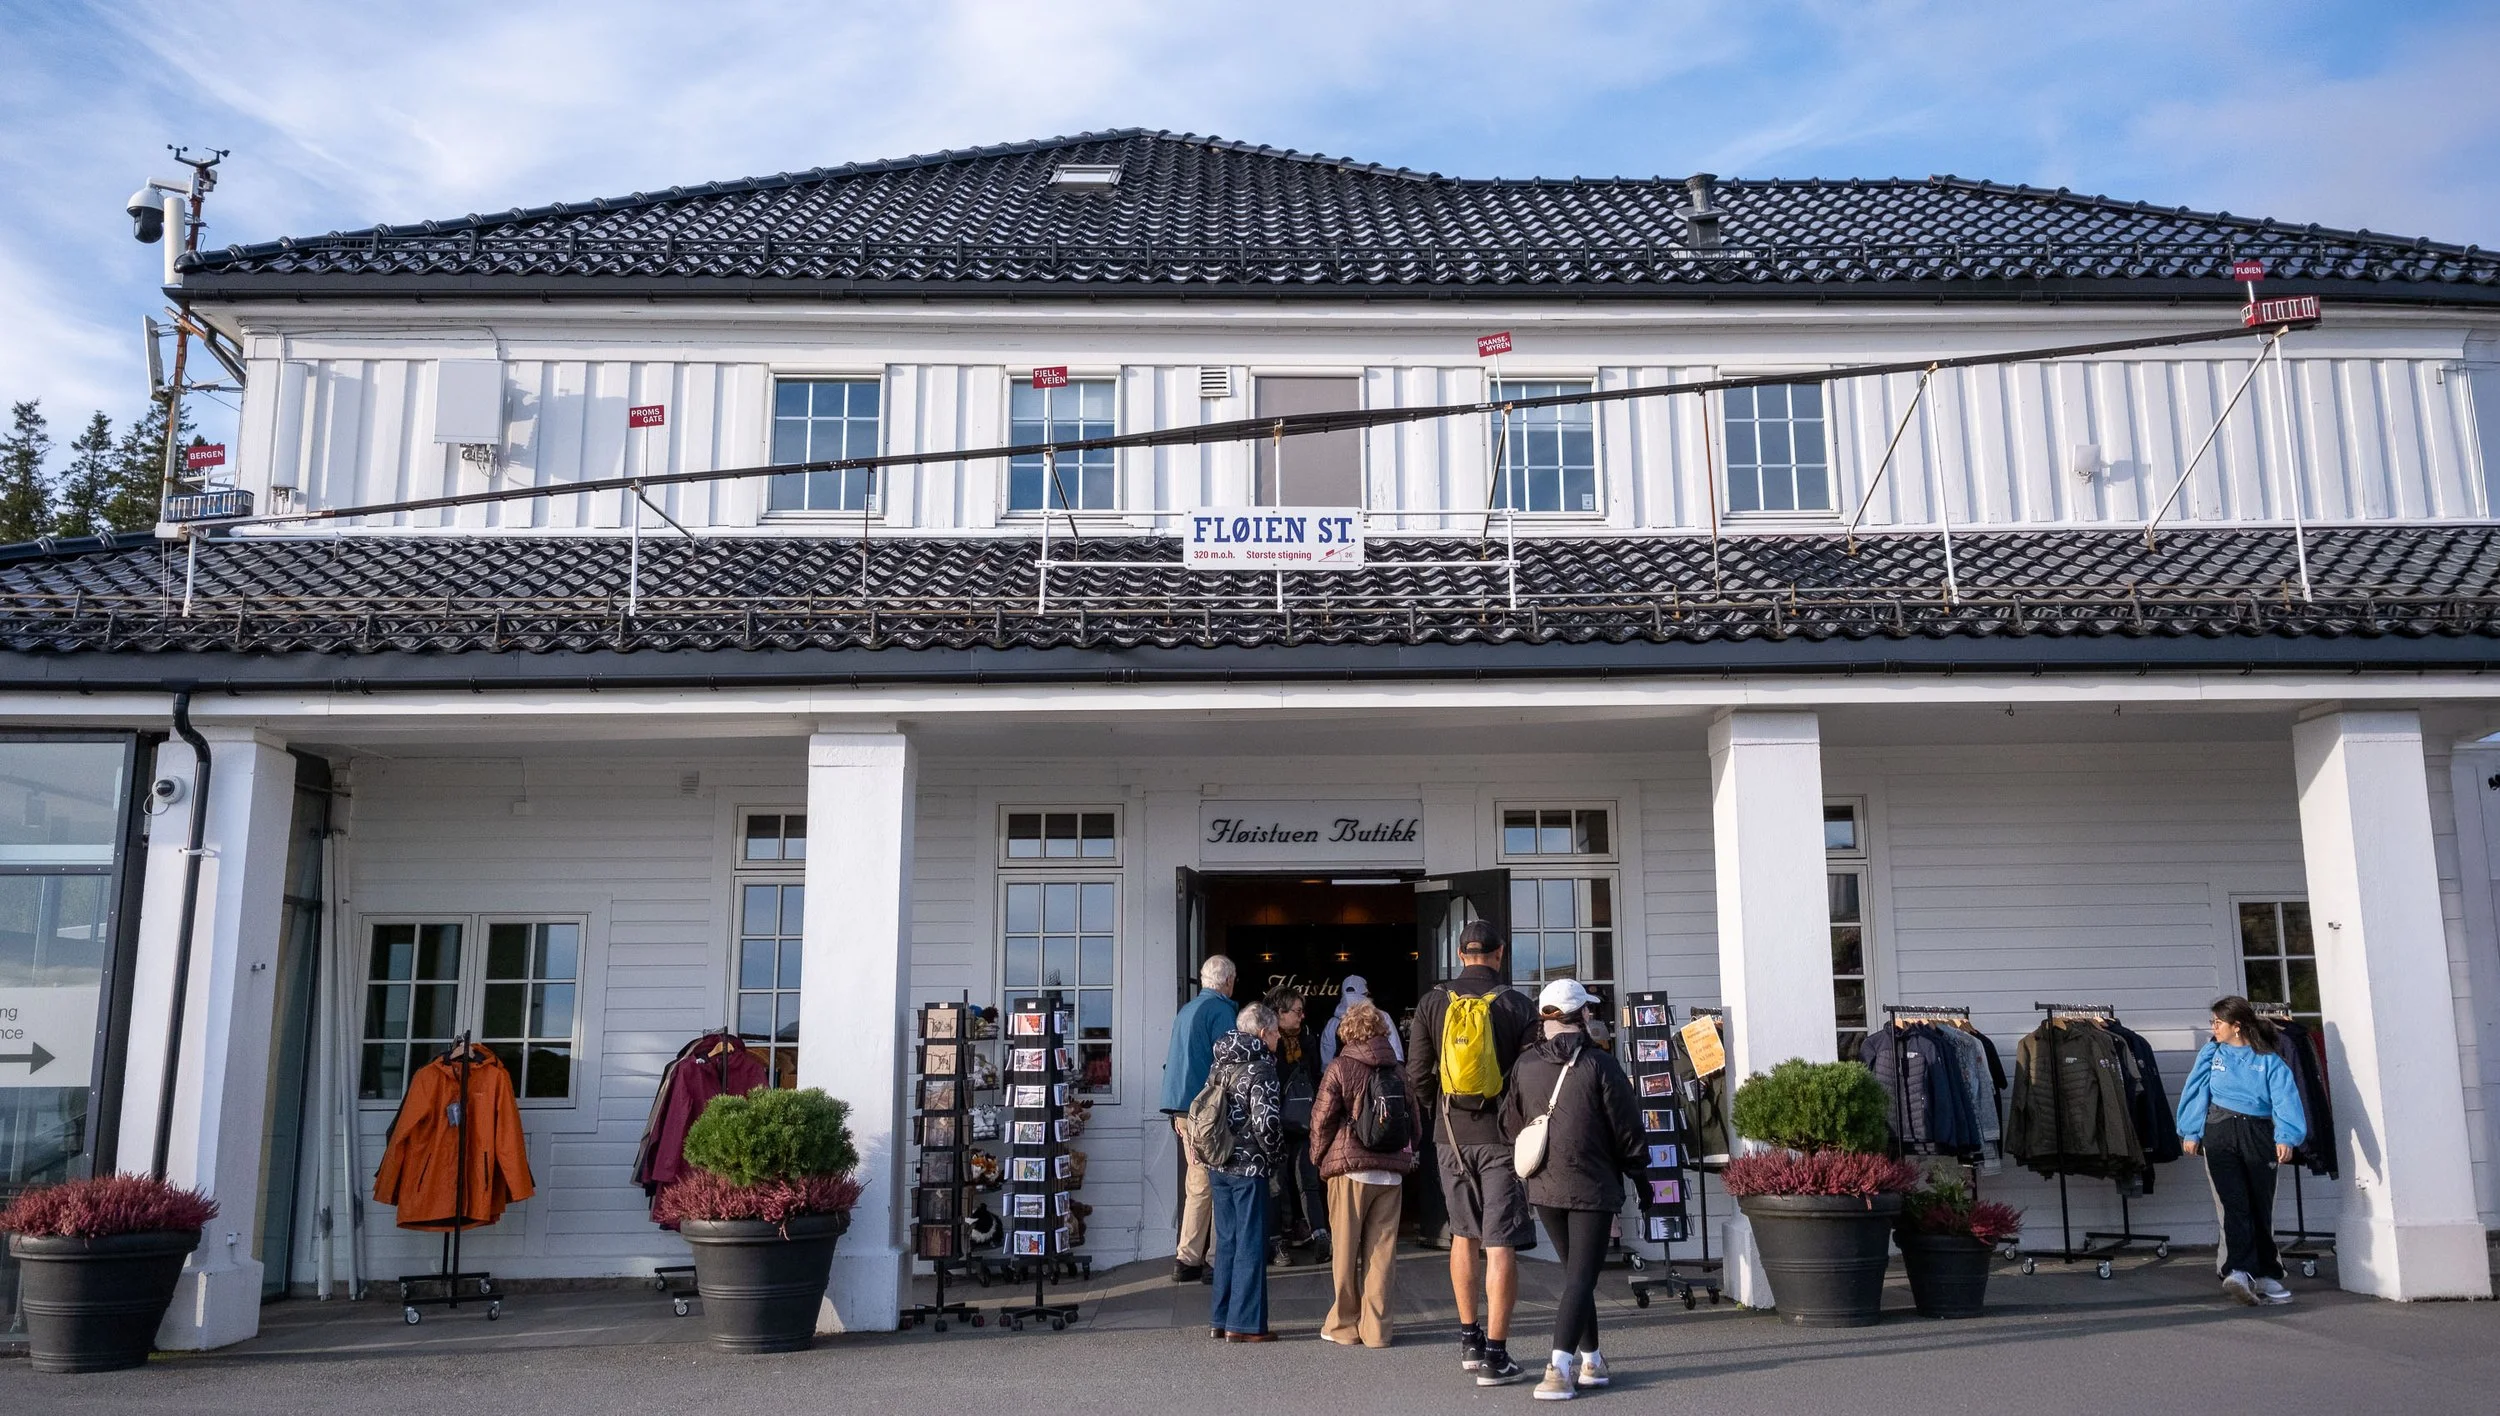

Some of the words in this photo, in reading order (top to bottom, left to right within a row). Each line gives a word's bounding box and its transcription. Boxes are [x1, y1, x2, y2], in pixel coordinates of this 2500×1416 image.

[2236, 266, 2262, 275] FLØIEN
[1486, 341, 1511, 352] MYREN
[1034, 369, 1060, 378] FJELL-
[1041, 376, 1066, 385] VEIEN
[631, 408, 660, 417] PROMS
[643, 414, 663, 424] GATE
[190, 450, 224, 460] BERGEN
[1193, 517, 1307, 543] FLØIEN
[1318, 517, 1356, 543] ST.
[1193, 550, 1209, 559] 320
[1210, 550, 1236, 559] m.o.h.
[1246, 550, 1276, 559] Største
[1277, 550, 1312, 561] stigning
[1328, 818, 1419, 843] Butikk
